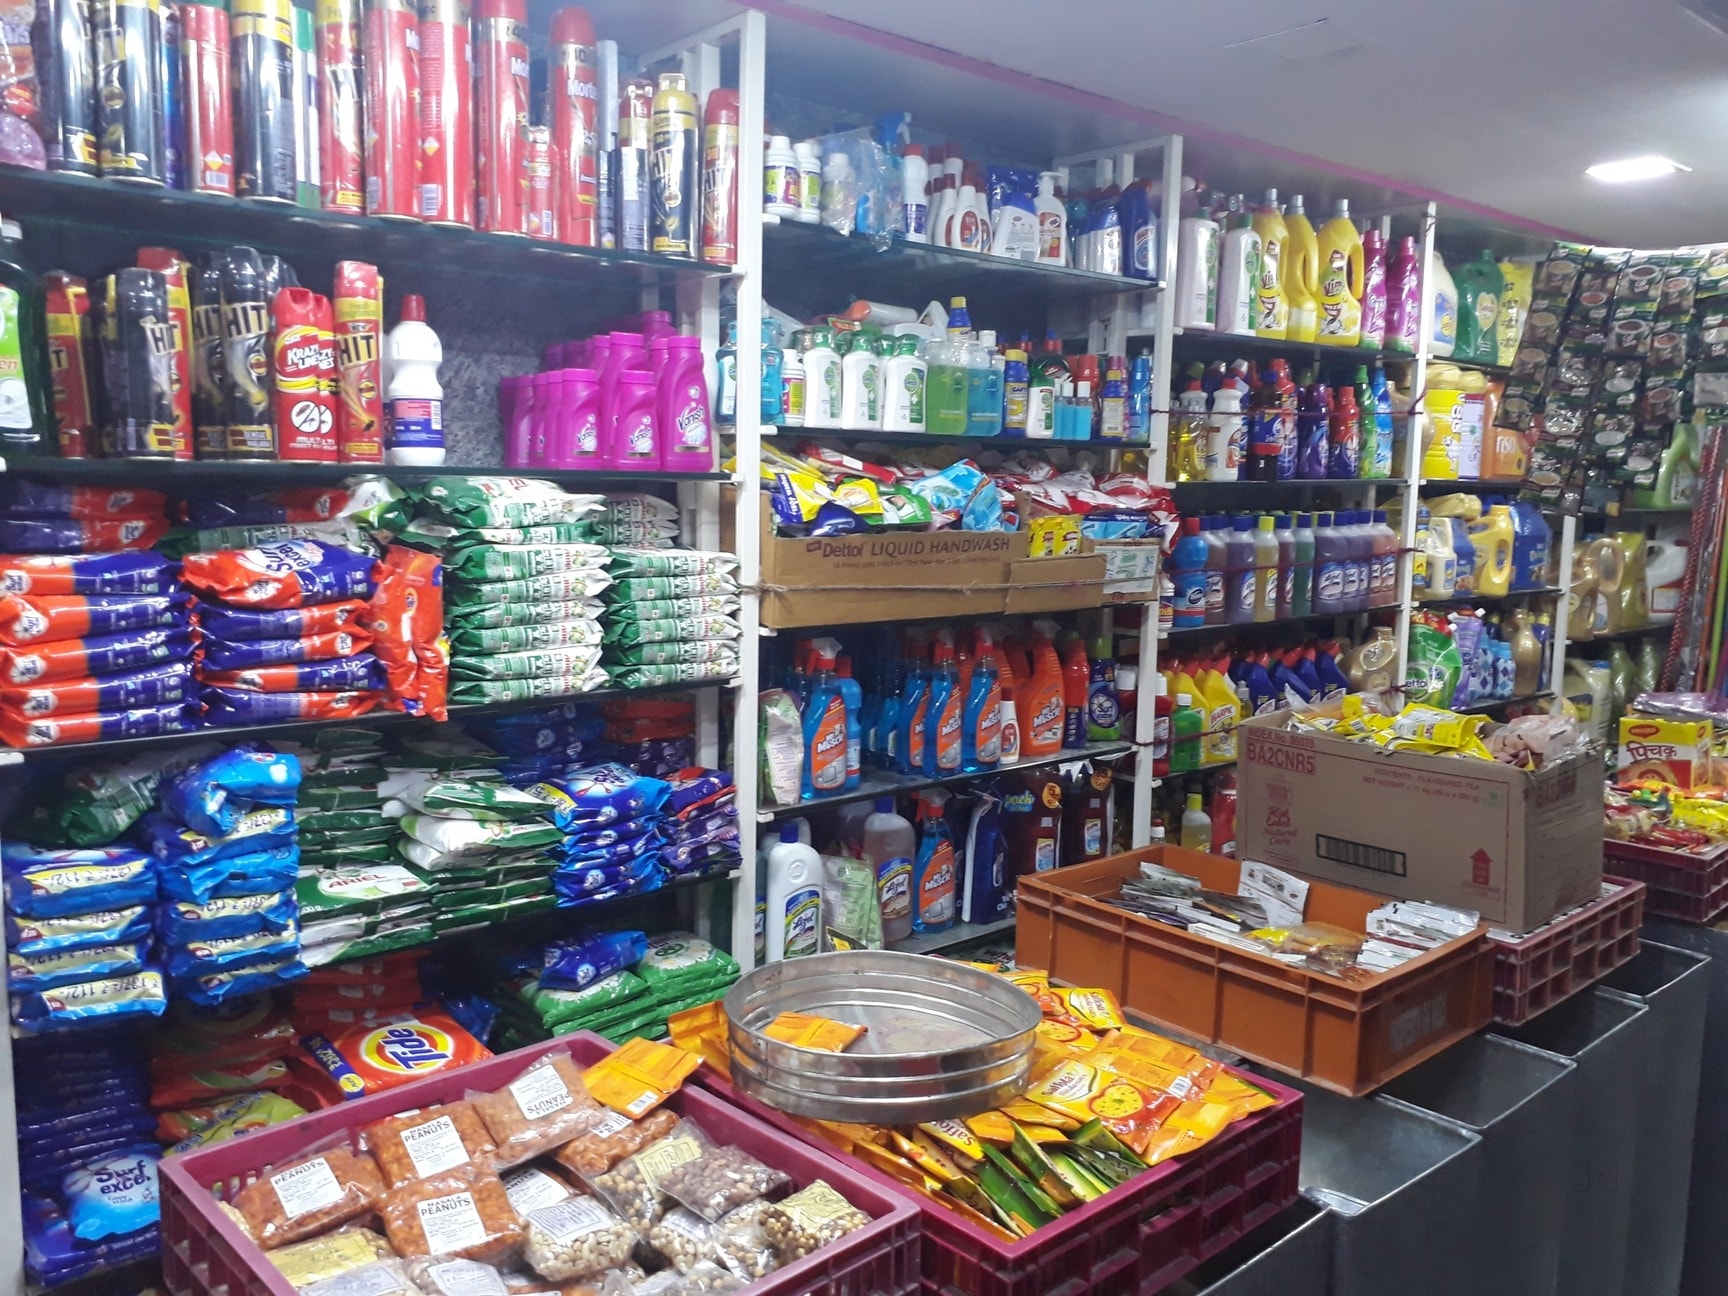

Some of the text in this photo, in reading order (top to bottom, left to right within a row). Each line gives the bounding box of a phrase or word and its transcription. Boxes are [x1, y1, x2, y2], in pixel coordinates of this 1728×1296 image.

[567, 79, 598, 100] Morte
[1323, 278, 1344, 297] Vim
[226, 303, 266, 340] HIT
[339, 333, 376, 367] HIT
[677, 405, 705, 432] Vanish
[276, 543, 311, 567] excel
[822, 536, 1010, 559] Dettol LIQUID HANDWASH
[1247, 742, 1315, 774] BA2CNR5
[328, 873, 386, 889] ARIEL
[793, 907, 818, 932] Lizol
[381, 1028, 450, 1070] Tide
[1041, 1075, 1075, 1096] Saffola
[526, 1090, 570, 1115] PEANUTS
[405, 1120, 451, 1143] PEANUTS
[931, 1119, 977, 1149] Saffo
[94, 1160, 147, 1183] Surf
[275, 1160, 324, 1185] PEANUTS
[505, 1172, 536, 1191] ANUTS
[100, 1174, 152, 1195] exce
[421, 1197, 471, 1217] PEANUTS
